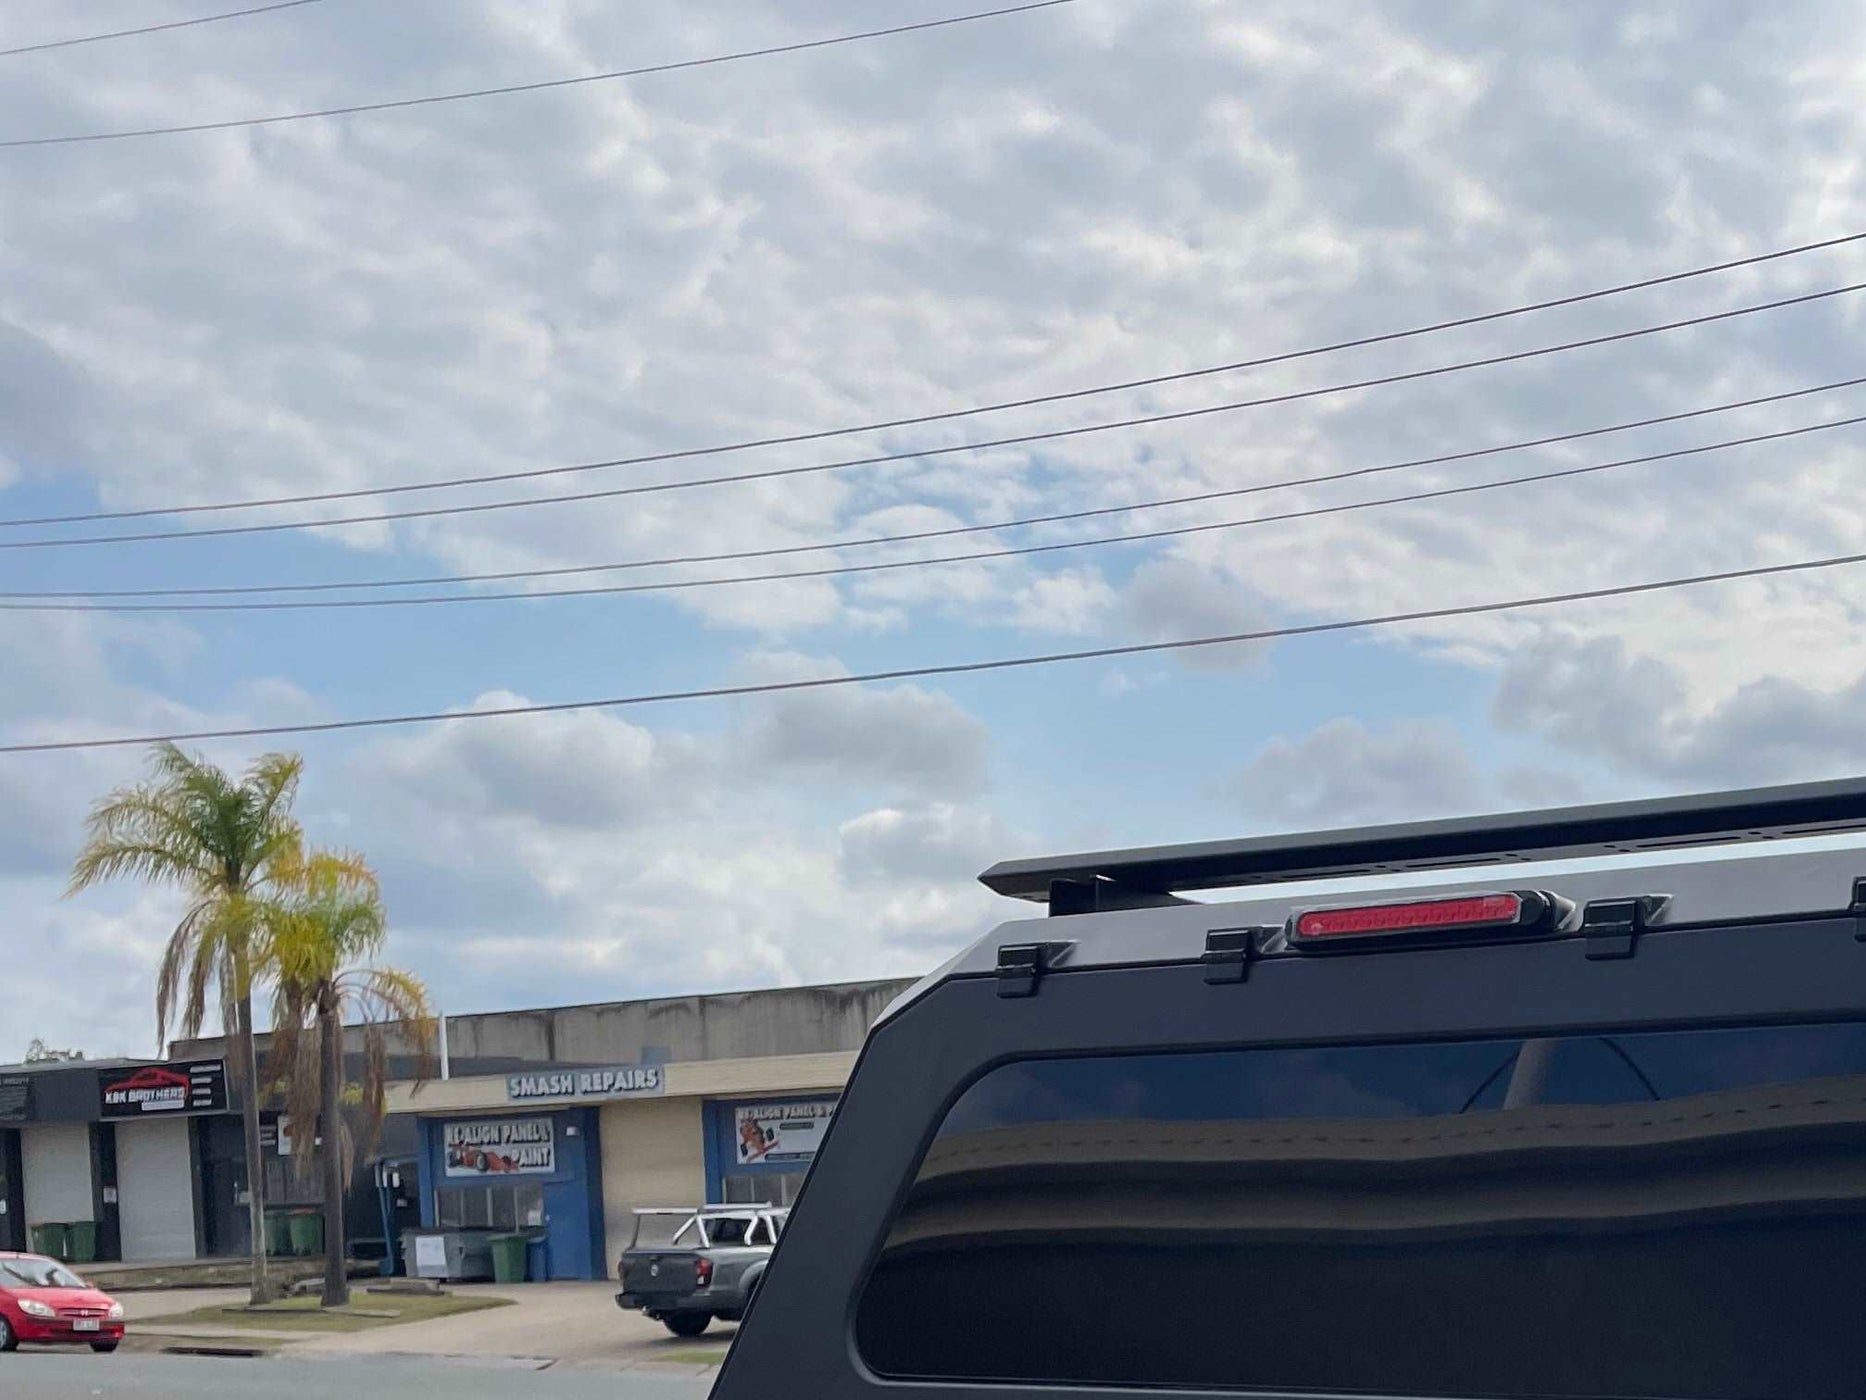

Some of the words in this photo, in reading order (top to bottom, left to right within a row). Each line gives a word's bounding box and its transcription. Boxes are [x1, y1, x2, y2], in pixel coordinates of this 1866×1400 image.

[510, 1075, 575, 1098] SMASH
[581, 1067, 659, 1094] REPAIRS
[511, 1148, 550, 1168] PAINT
